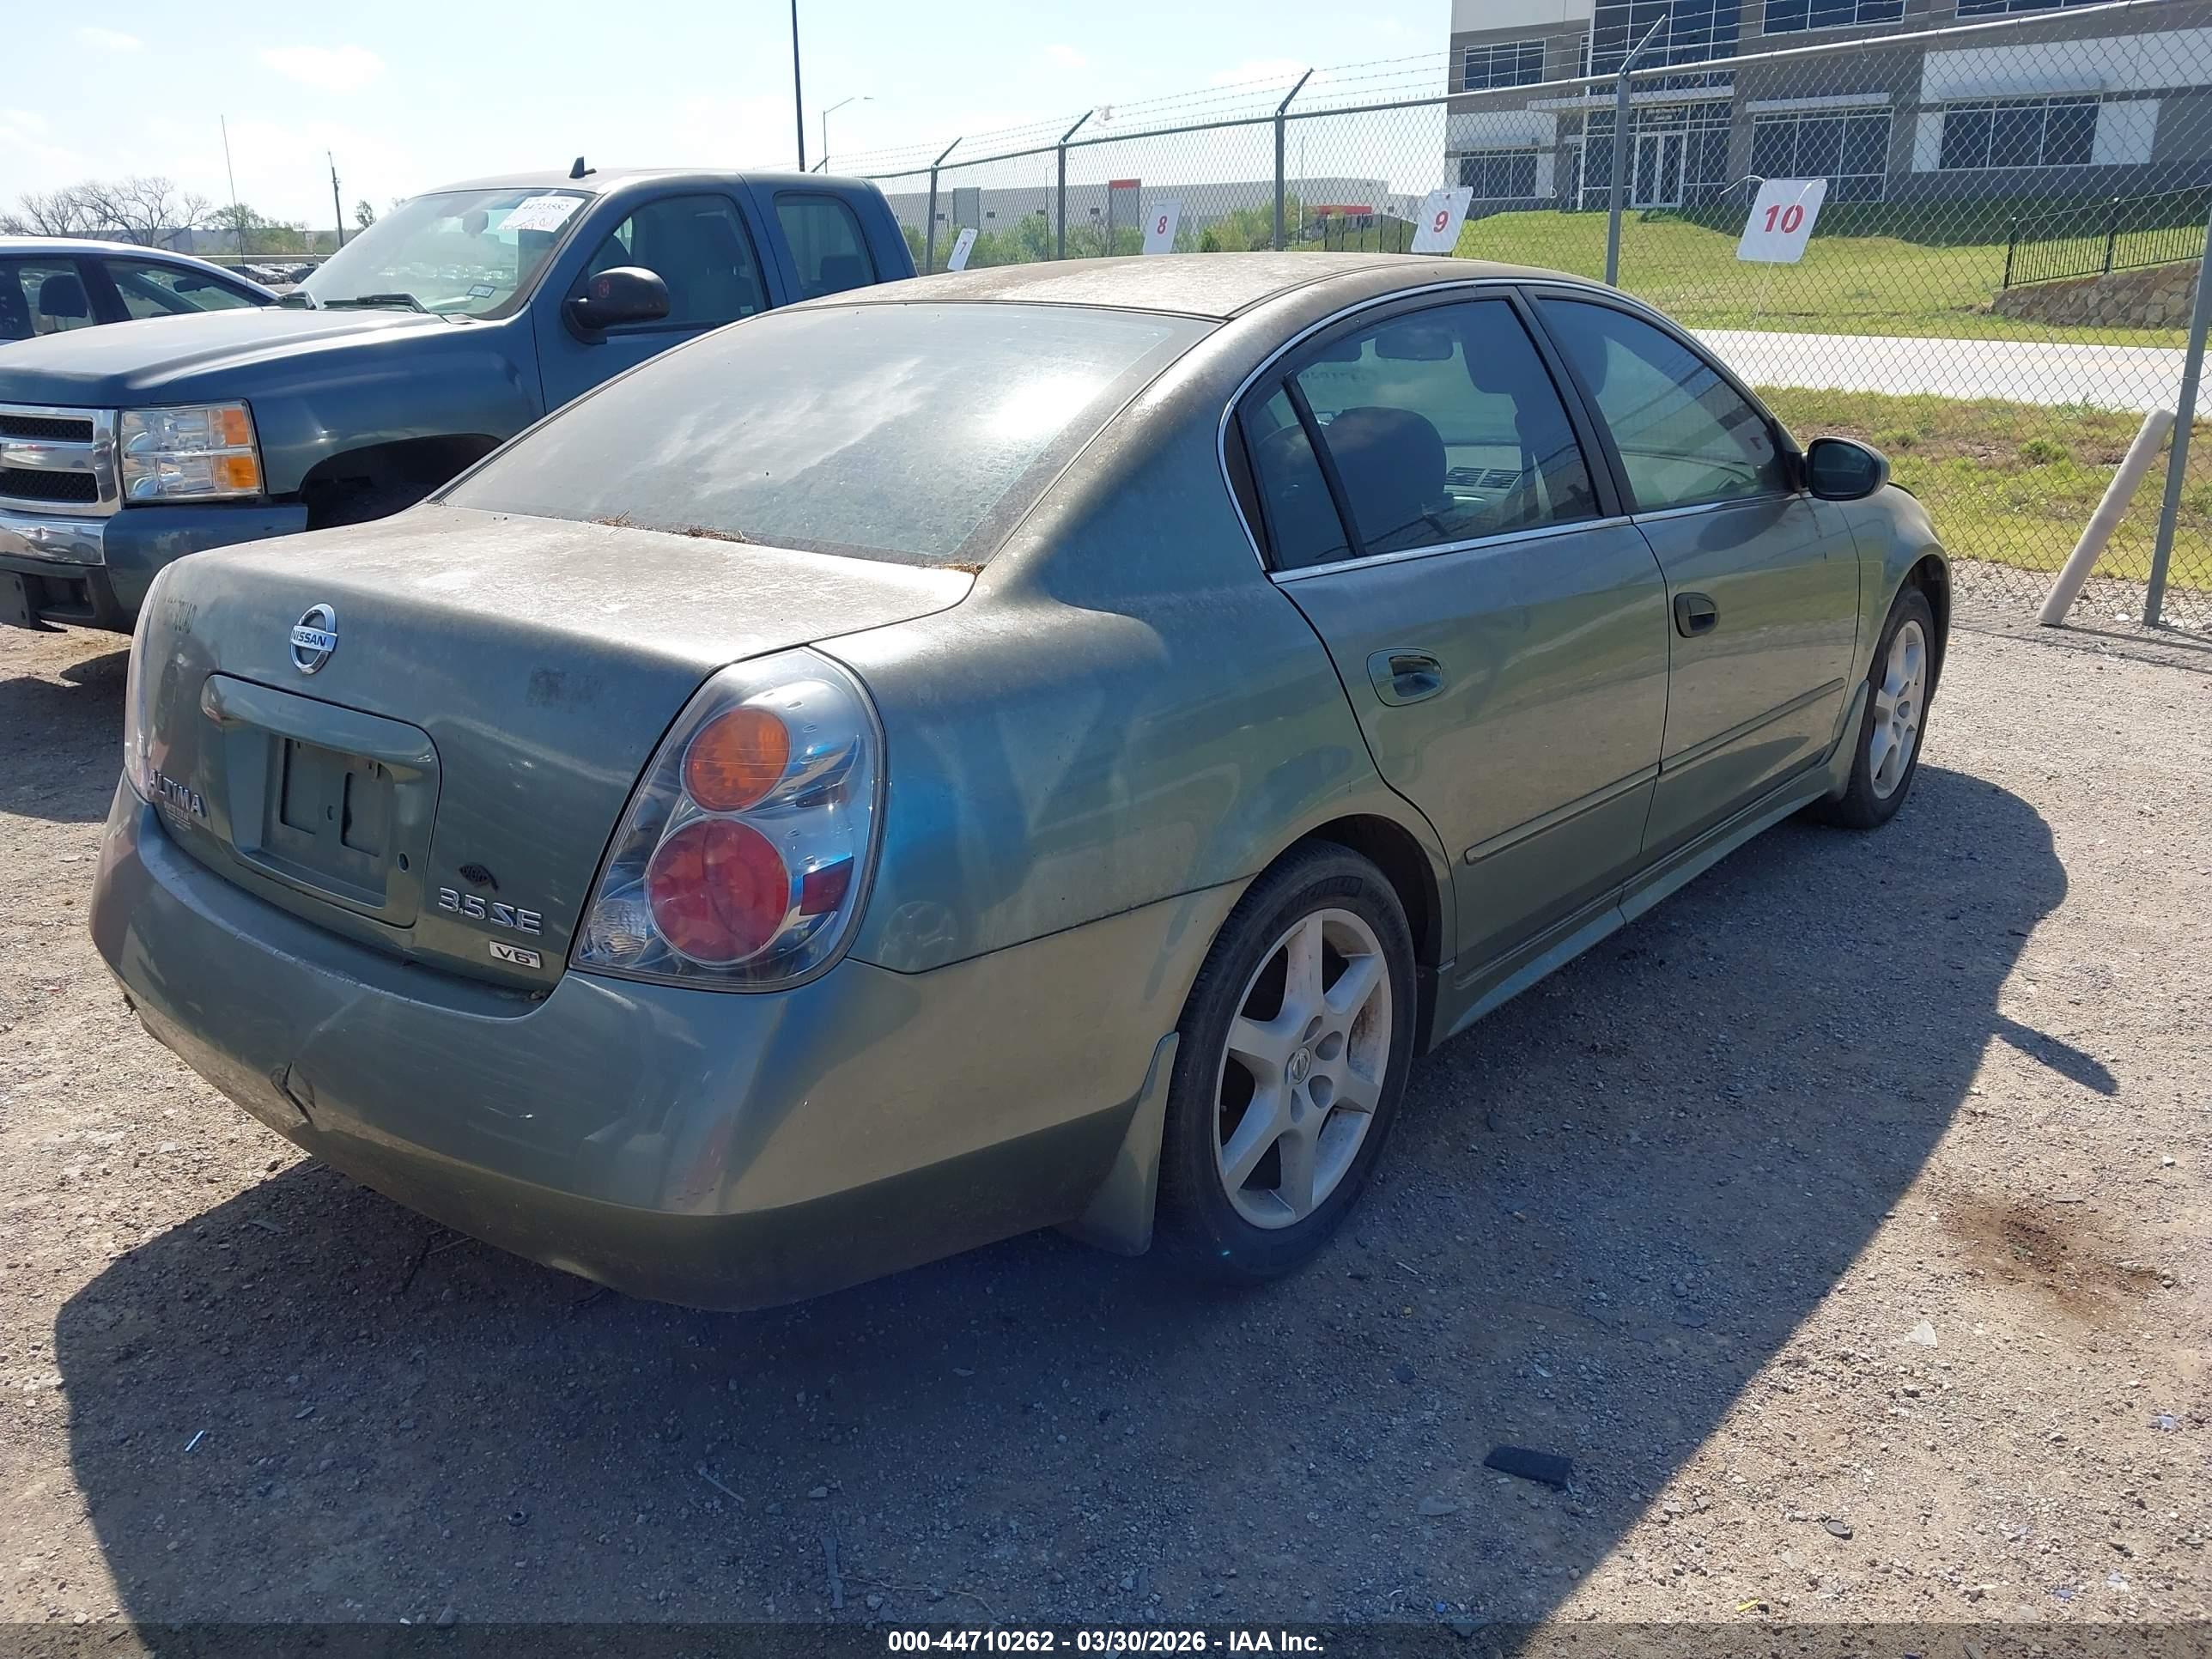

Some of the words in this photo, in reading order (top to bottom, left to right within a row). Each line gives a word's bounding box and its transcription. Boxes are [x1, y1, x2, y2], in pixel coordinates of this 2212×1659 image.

[1157, 216, 1168, 234] 8
[1432, 210, 1449, 233] 9
[1765, 204, 1804, 234] 10
[959, 241, 967, 256] 7
[292, 629, 326, 647] NISSAN
[149, 769, 206, 817] ALTIMA
[438, 886, 486, 920] 3.5
[489, 902, 542, 935] SE
[496, 946, 531, 964] V6
